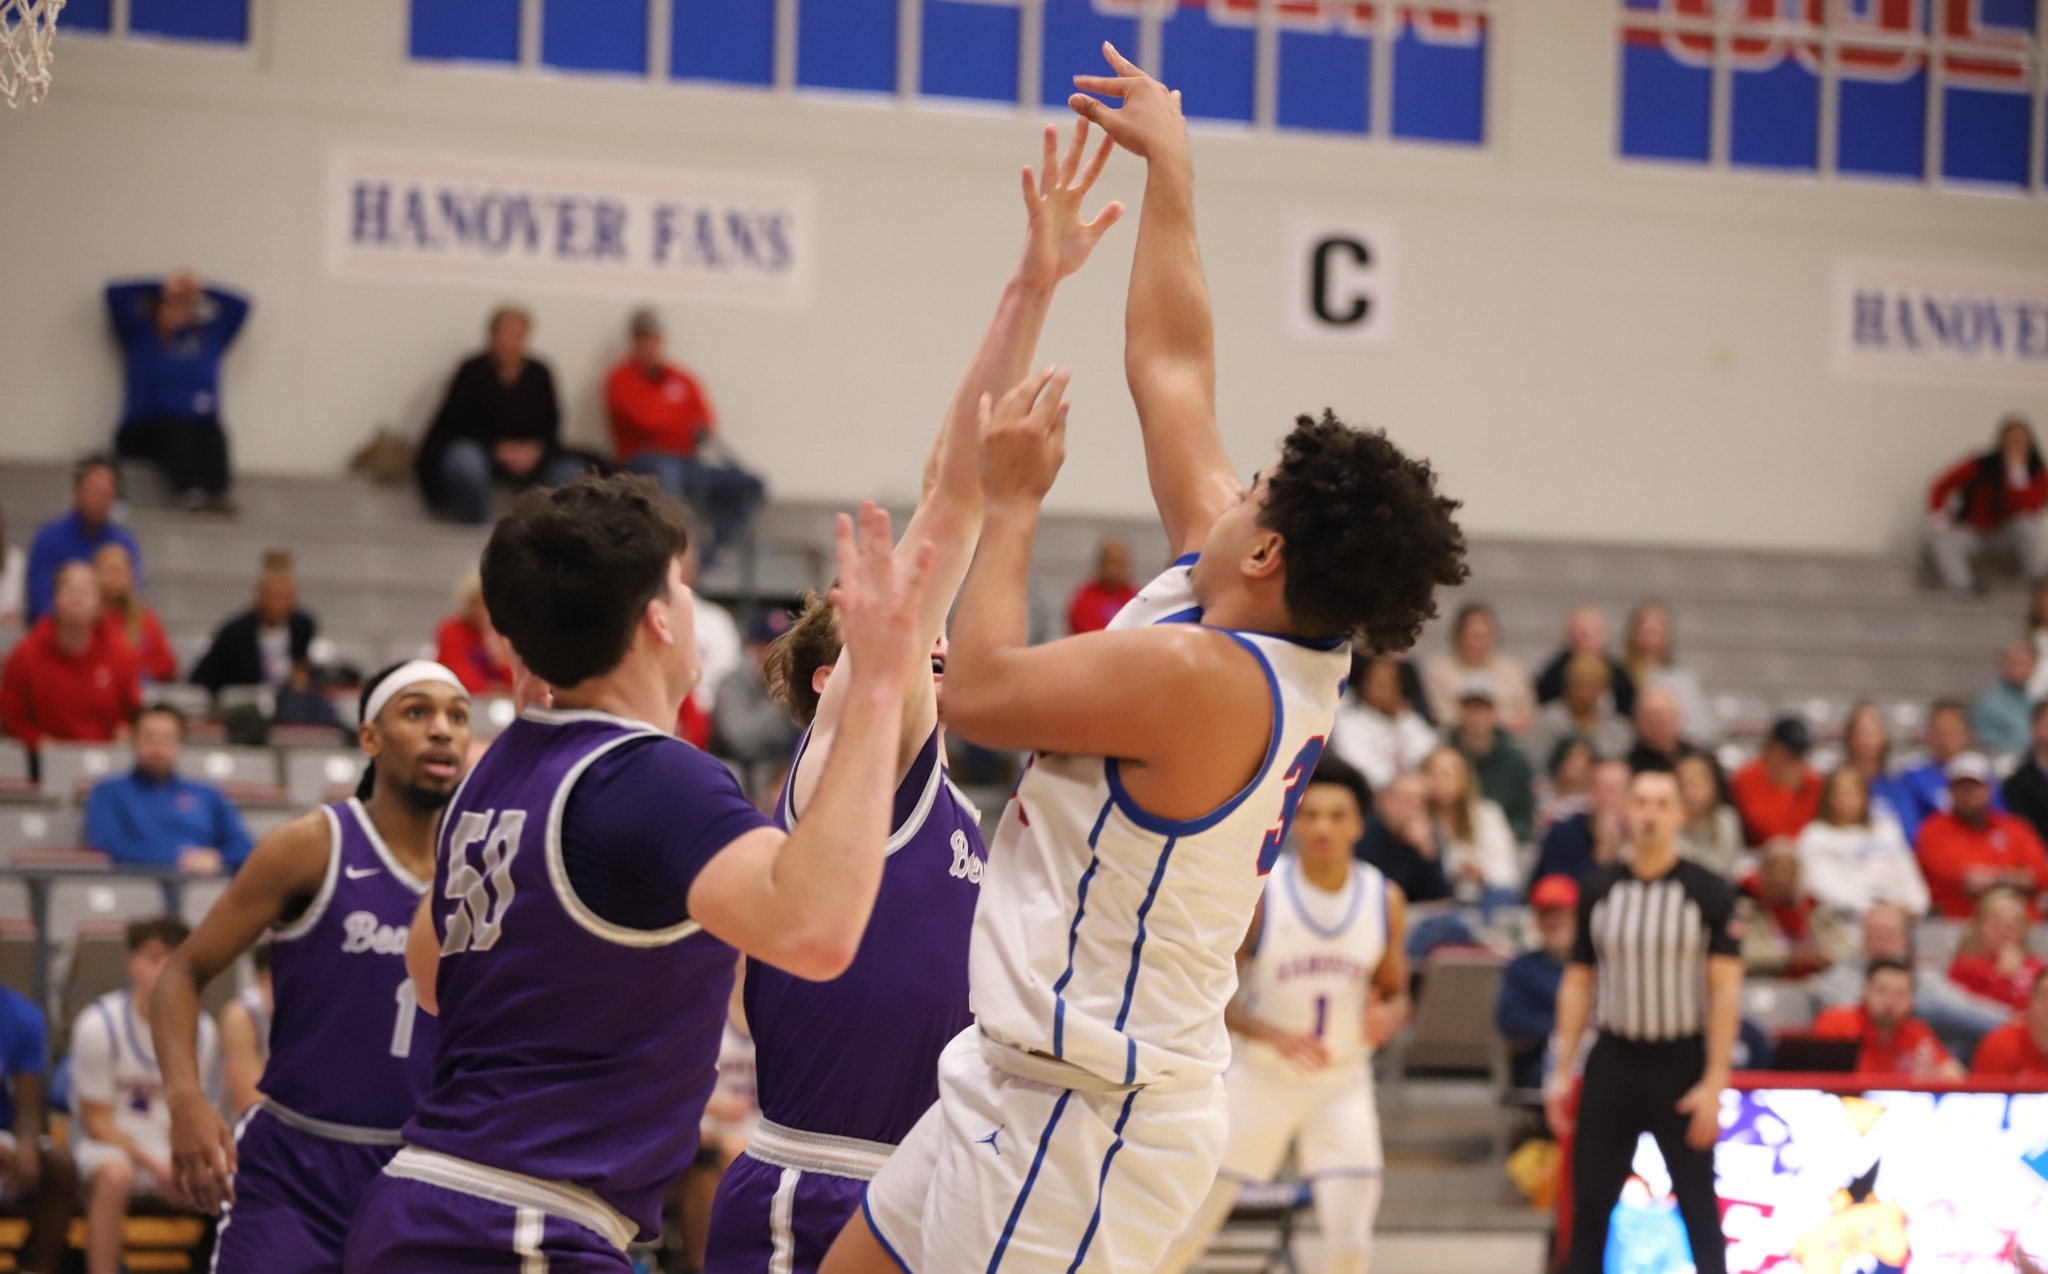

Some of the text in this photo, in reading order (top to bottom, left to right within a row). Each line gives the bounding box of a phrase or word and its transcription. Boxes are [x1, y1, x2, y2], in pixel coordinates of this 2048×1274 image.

[350, 178, 795, 275] HANOVER FANS
[1309, 234, 1372, 328] C
[441, 808, 527, 957] 50
[390, 977, 417, 1058] 1
